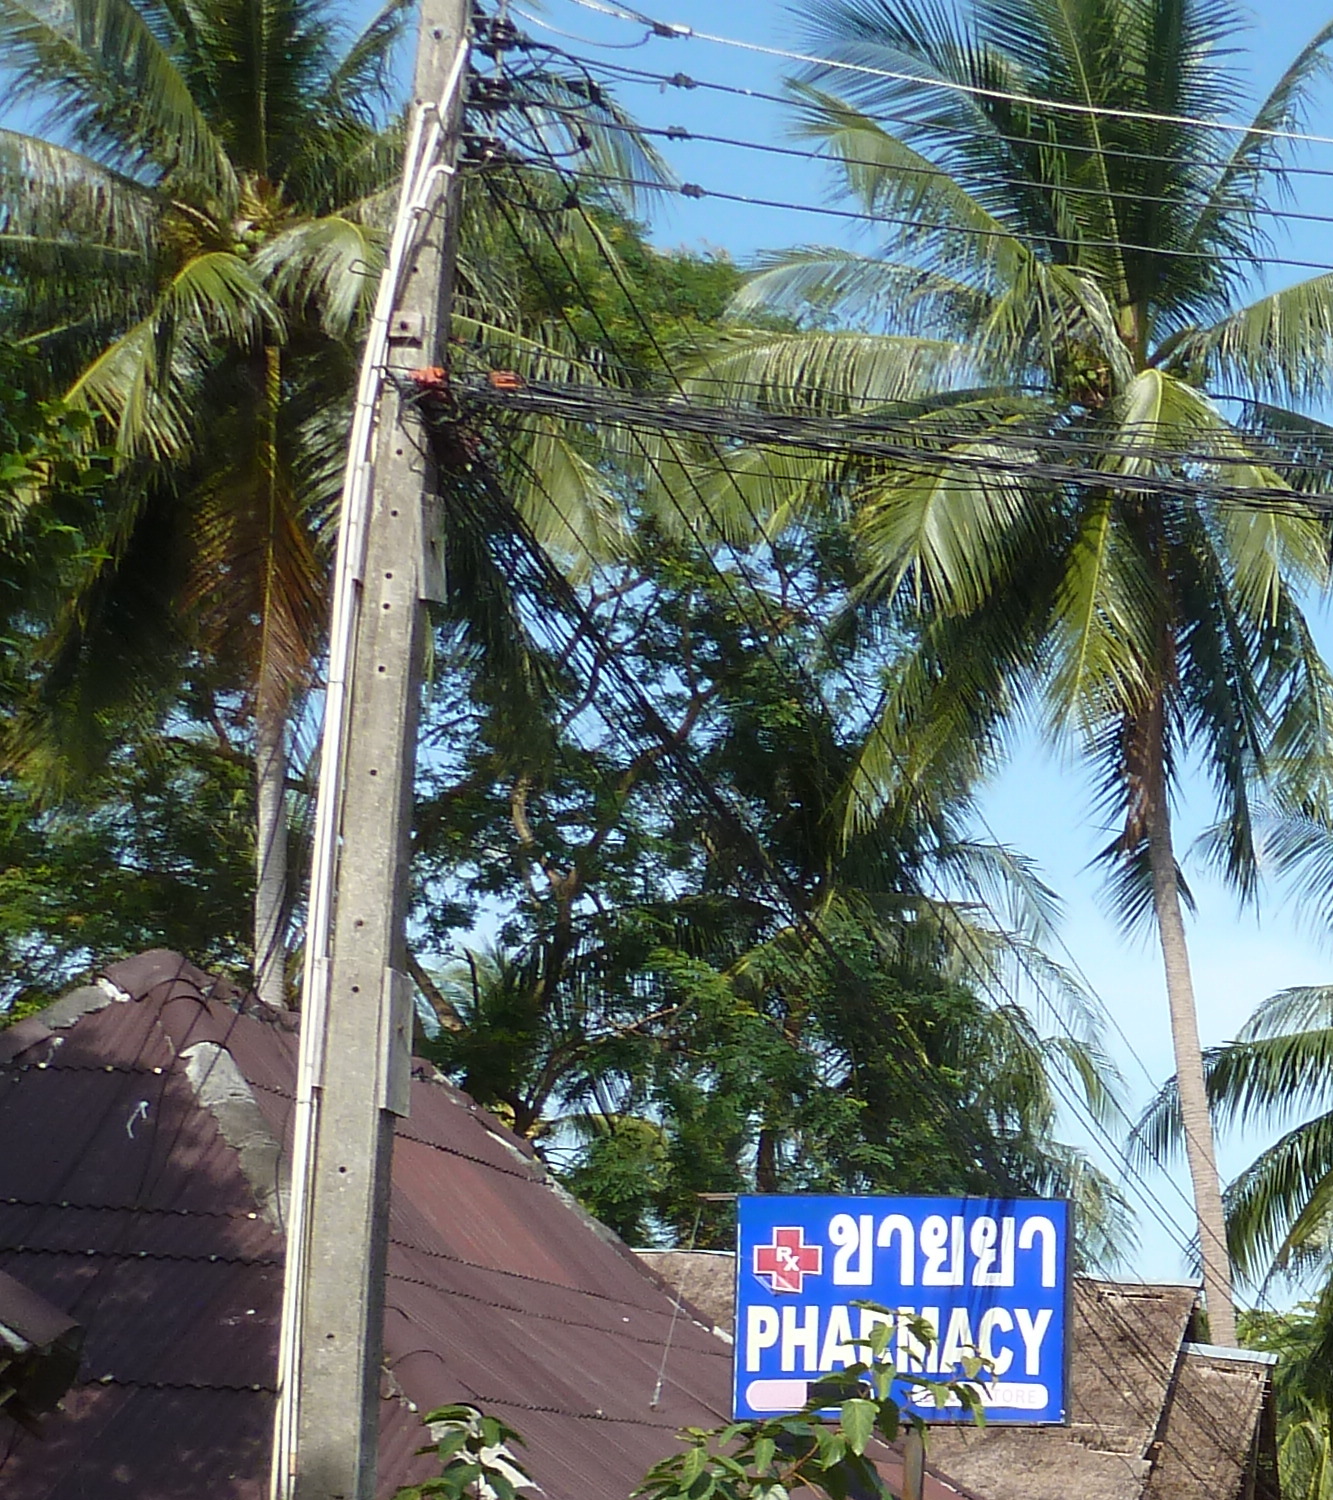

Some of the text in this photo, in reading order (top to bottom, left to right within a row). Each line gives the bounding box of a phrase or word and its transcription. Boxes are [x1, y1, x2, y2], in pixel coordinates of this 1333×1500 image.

[776, 1246, 800, 1271] Rx
[828, 1213, 1057, 1288] ขายยา
[983, 1386, 1038, 1406] TORE
